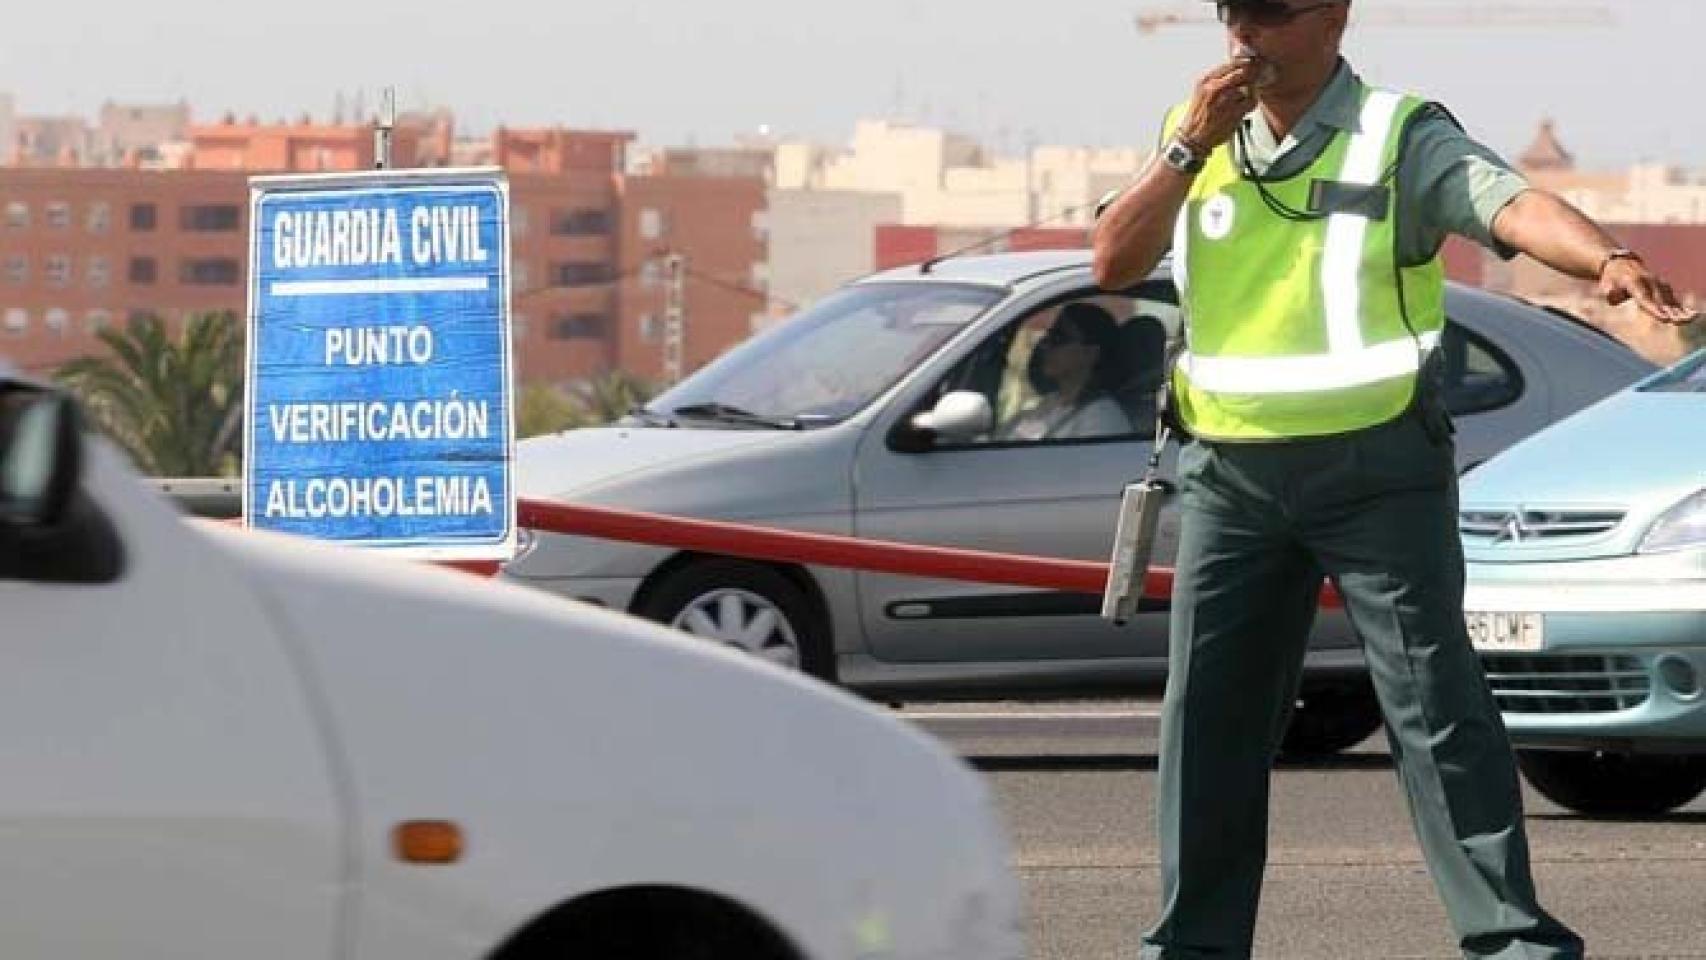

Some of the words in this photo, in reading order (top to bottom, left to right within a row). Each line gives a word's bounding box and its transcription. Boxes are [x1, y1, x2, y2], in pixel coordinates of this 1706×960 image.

[274, 208, 402, 268] GUARDIA
[411, 206, 487, 264] CIVIL
[325, 326, 433, 366] PUNTO
[269, 390, 488, 441] VERIFICACIÓN
[265, 476, 492, 518] ALCOHOLEMIA
